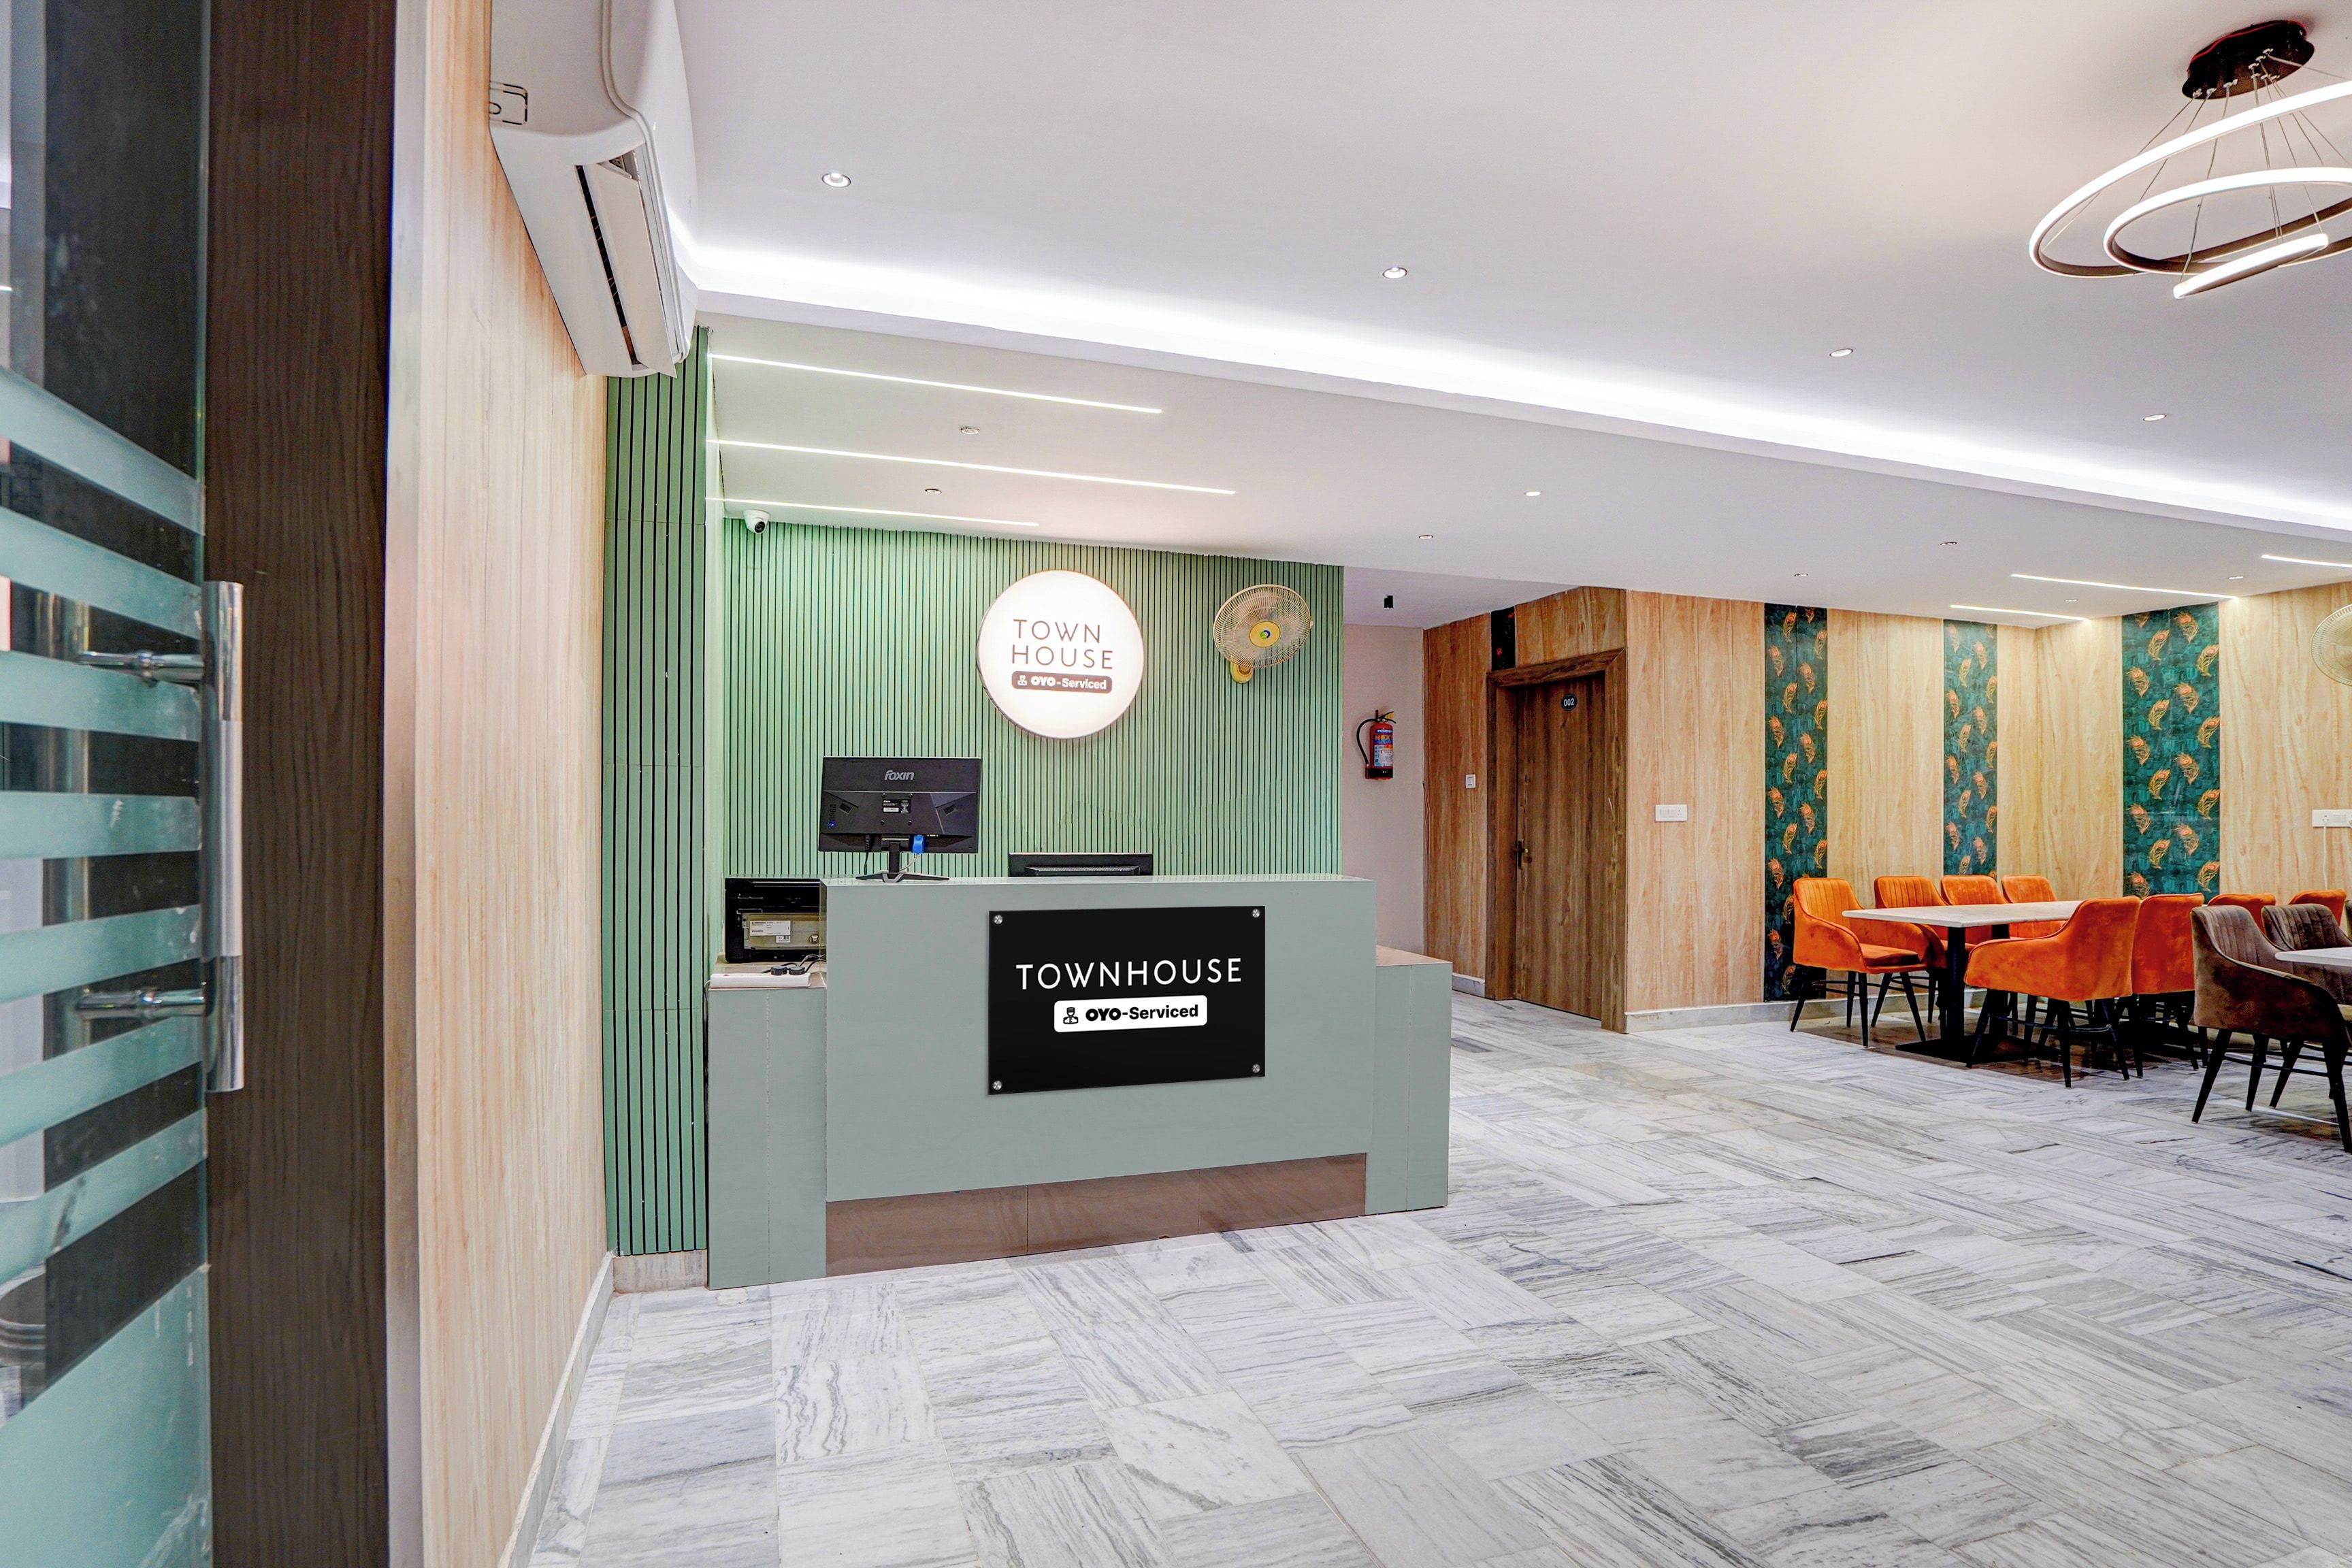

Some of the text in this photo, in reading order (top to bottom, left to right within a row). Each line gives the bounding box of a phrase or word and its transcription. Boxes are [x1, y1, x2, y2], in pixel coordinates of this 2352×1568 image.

[1013, 619, 1100, 643] TOWN
[1012, 644, 1113, 669] HOUSE
[1563, 698, 1575, 706] 002
[884, 770, 915, 781] foxin
[1016, 958, 1241, 990] TOWNHOUSE
[1085, 1004, 1198, 1022] OYO-Serviced
